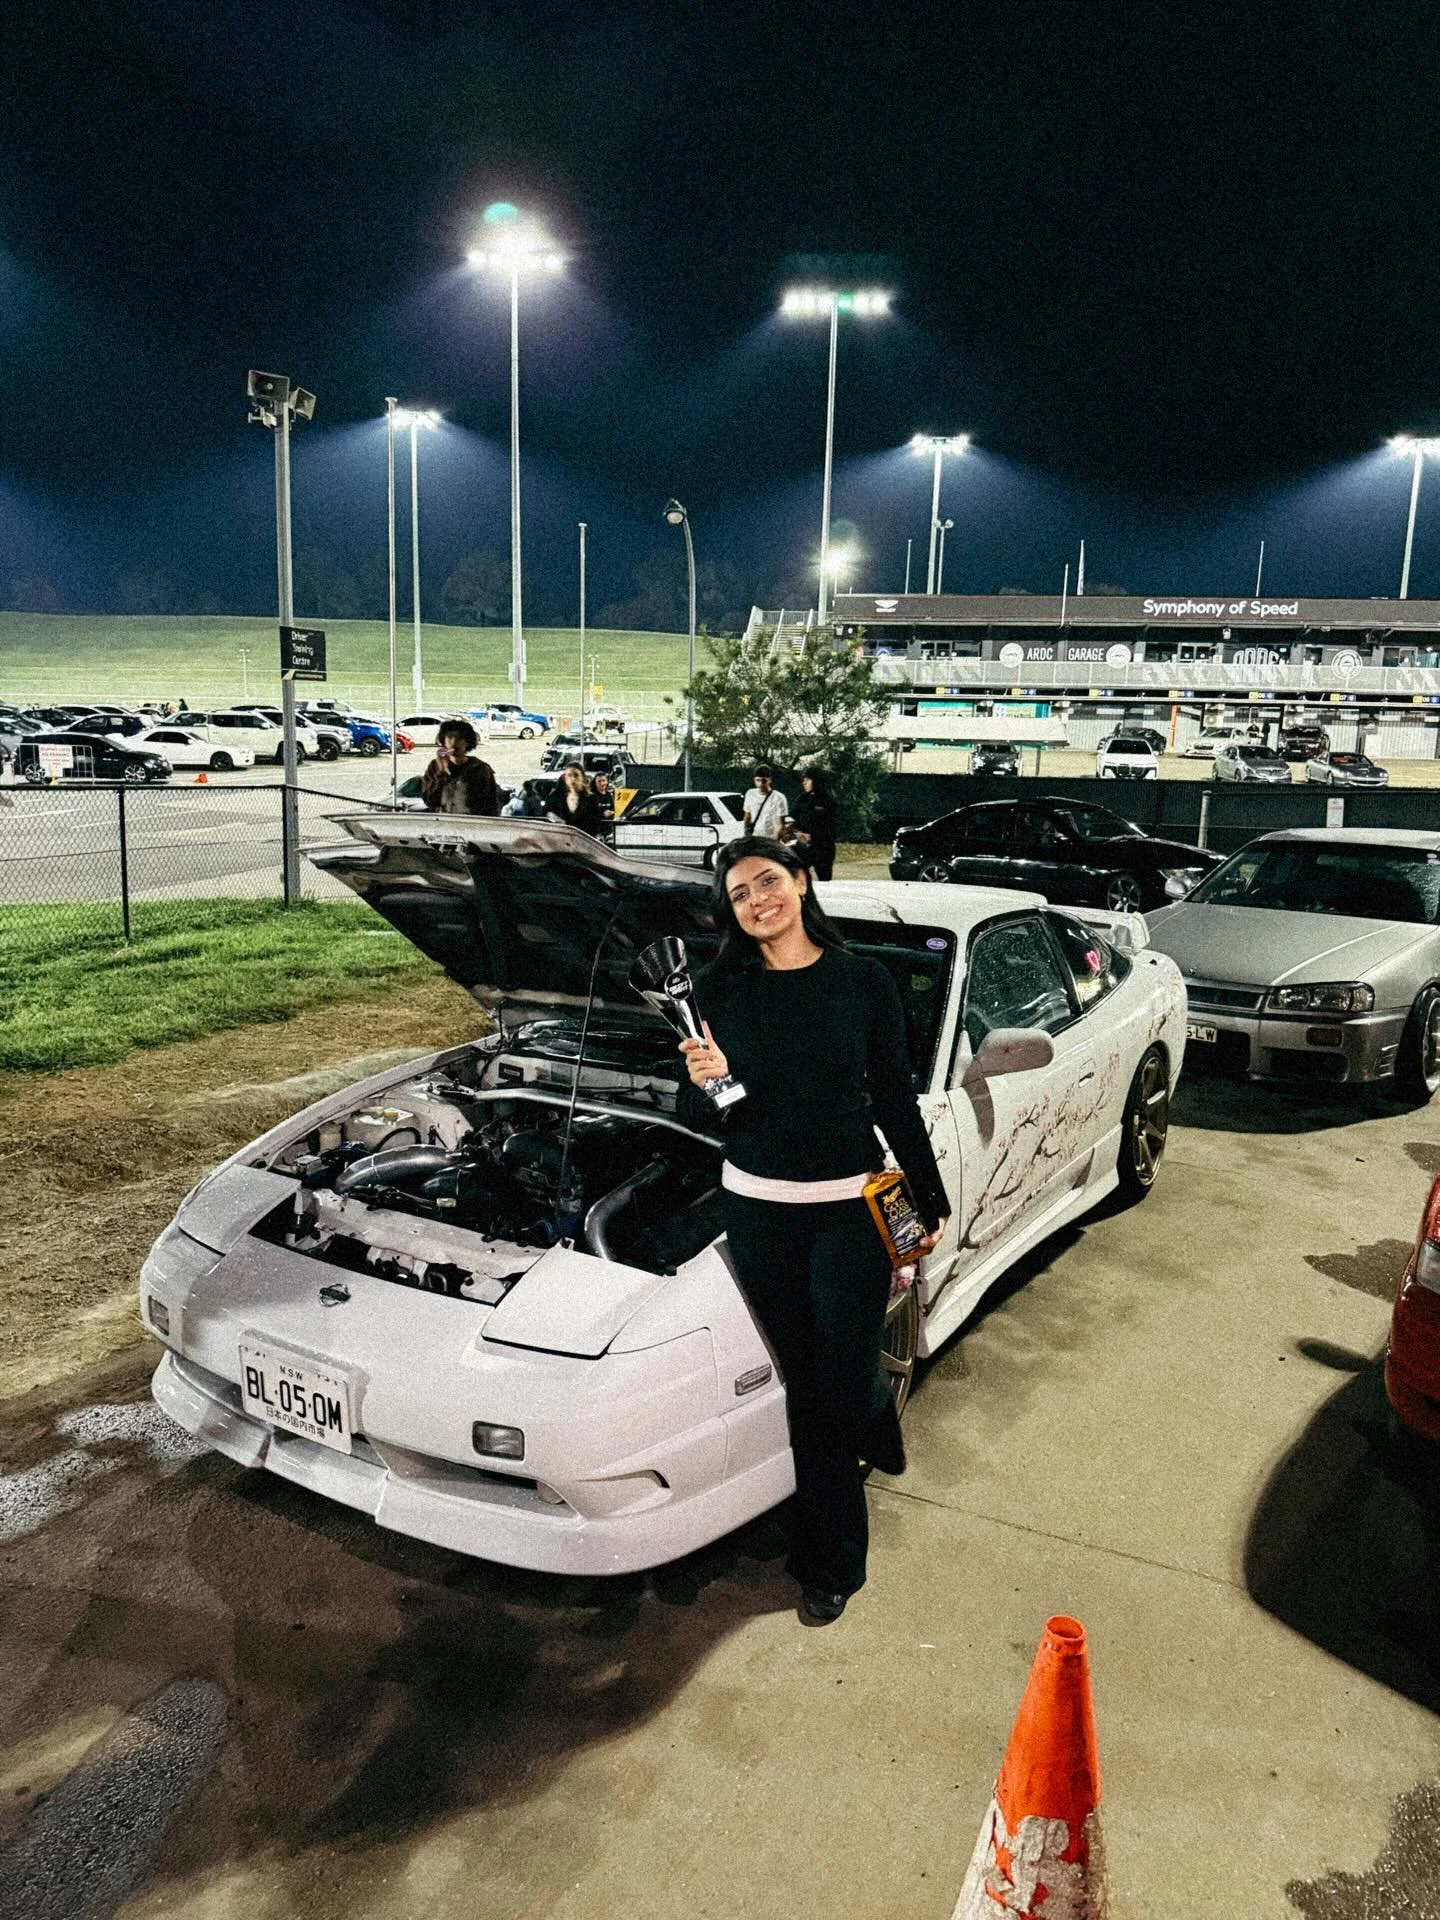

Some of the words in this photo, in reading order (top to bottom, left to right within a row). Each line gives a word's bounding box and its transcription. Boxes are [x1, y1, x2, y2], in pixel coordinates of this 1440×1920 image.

[1143, 600, 1225, 617] Symphony
[1229, 601, 1247, 614] of
[1250, 601, 1299, 617] Speed
[1027, 648, 1053, 660] ARDC
[1068, 648, 1105, 660] GARAGE
[280, 1366, 303, 1381] NSW
